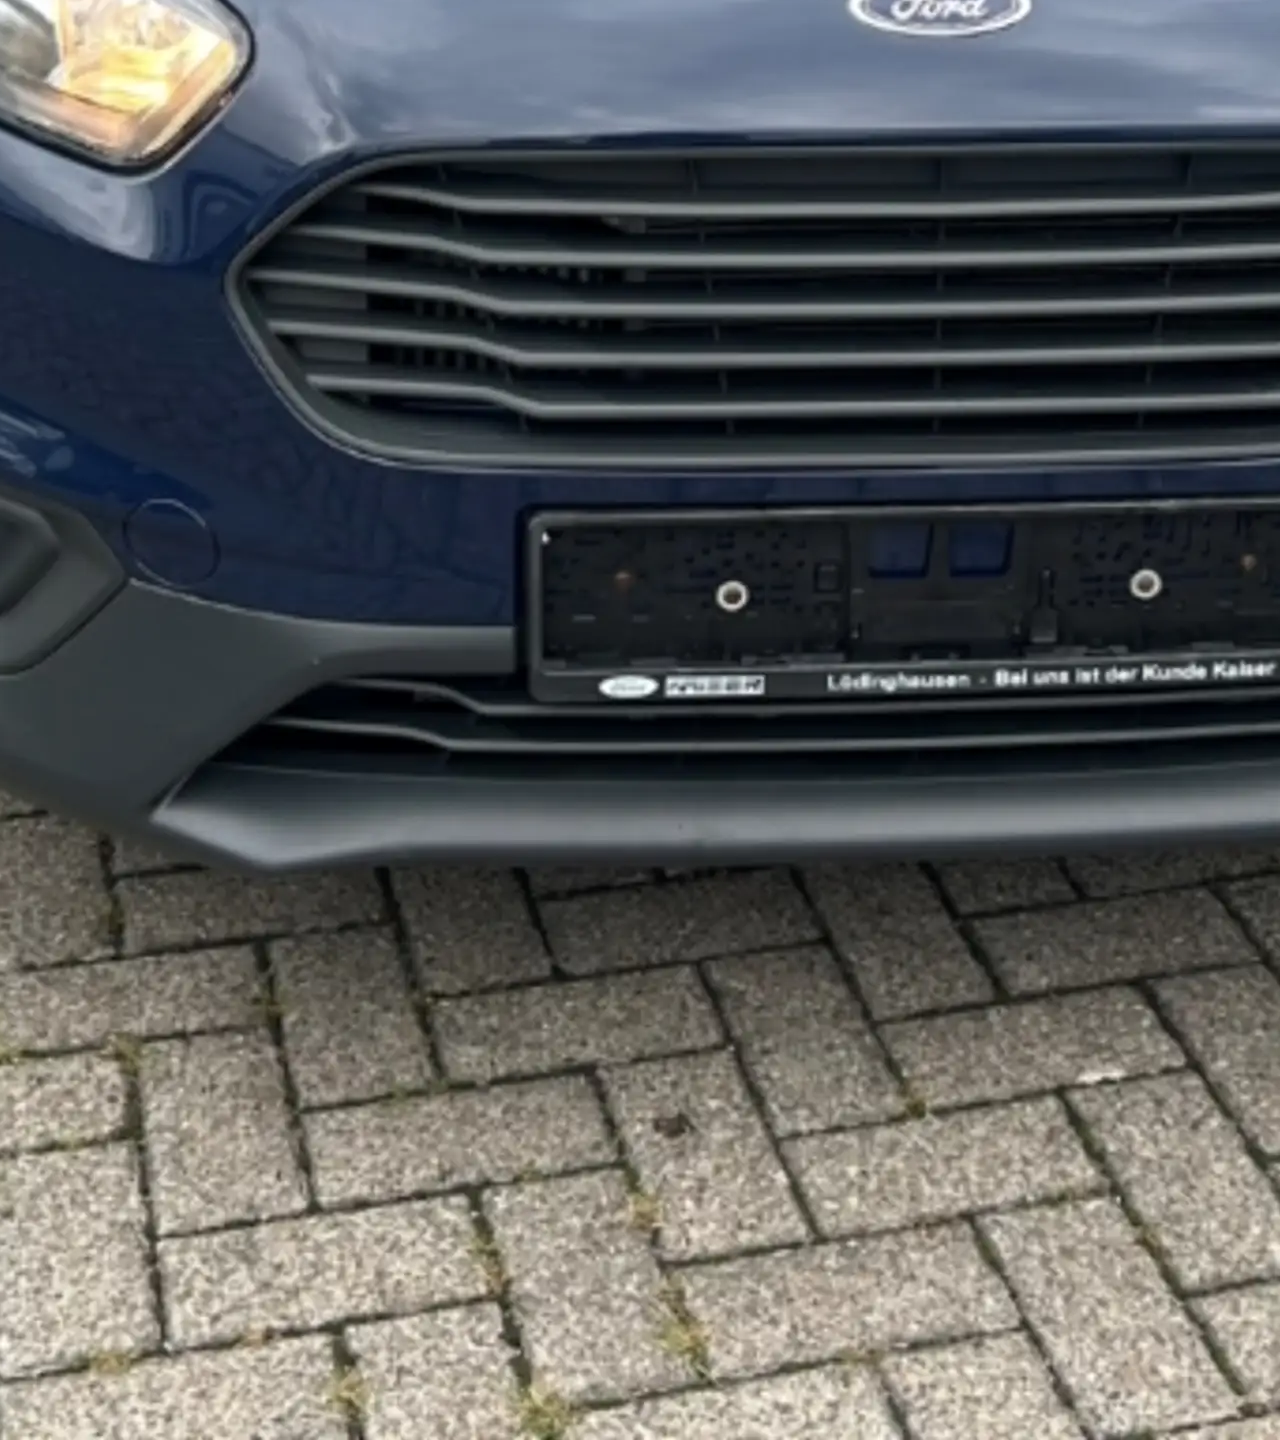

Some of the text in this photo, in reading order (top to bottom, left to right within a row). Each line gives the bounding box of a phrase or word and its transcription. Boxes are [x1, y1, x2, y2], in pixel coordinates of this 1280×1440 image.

[994, 668, 1028, 687] Bei
[1033, 670, 1068, 685] uns
[1075, 666, 1100, 684] ist
[1105, 664, 1138, 684] der
[1142, 663, 1207, 681] Kunde
[1212, 661, 1277, 679] Kaiser
